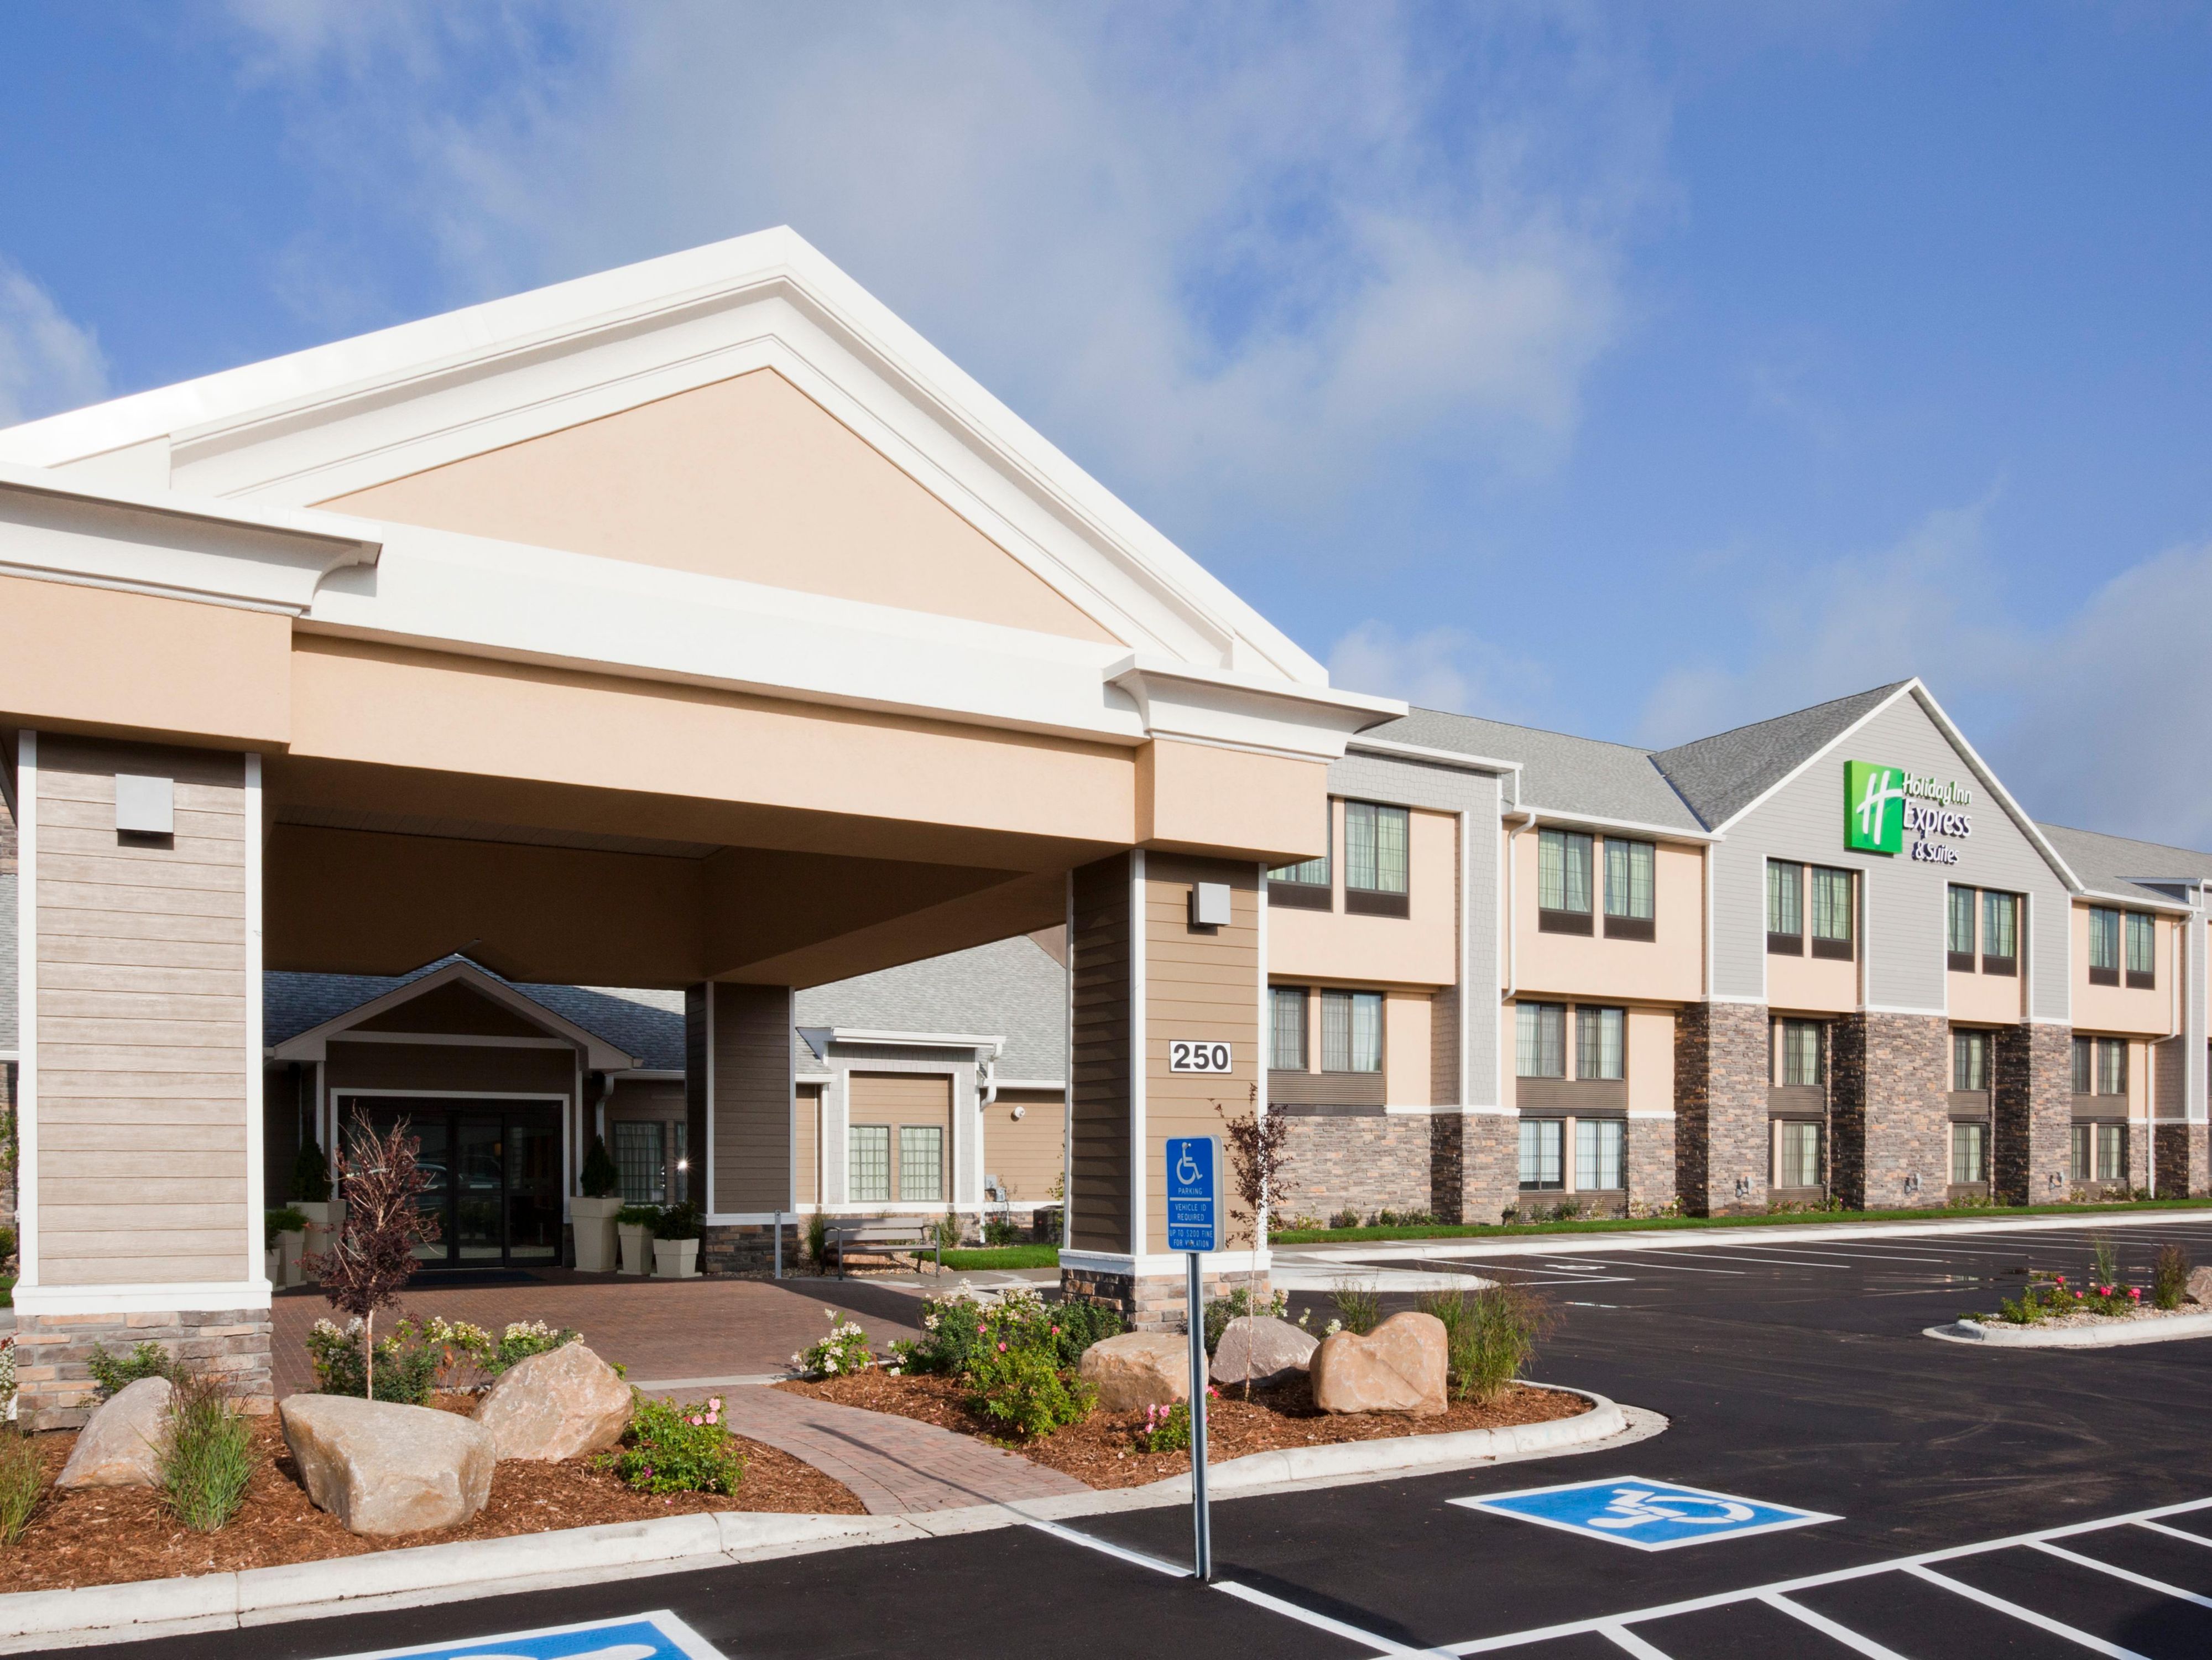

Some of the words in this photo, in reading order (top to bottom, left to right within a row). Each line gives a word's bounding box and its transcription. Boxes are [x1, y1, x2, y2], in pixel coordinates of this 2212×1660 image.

[1902, 772, 1952, 805] Holiday
[1952, 780, 1972, 804] Inn
[1903, 798, 1972, 838] Express
[1916, 840, 1926, 859] &
[1926, 842, 1960, 863] Suites
[1173, 1043, 1229, 1070] 250
[1178, 1187, 1203, 1195] PARKING
[1175, 1203, 1198, 1211] VEHICLE
[1201, 1204, 1207, 1212] ID
[1177, 1213, 1204, 1221] REQUIRED
[1178, 1229, 1184, 1237] TO
[1201, 1230, 1213, 1239] FINE
[1173, 1239, 1183, 1247] FOR
